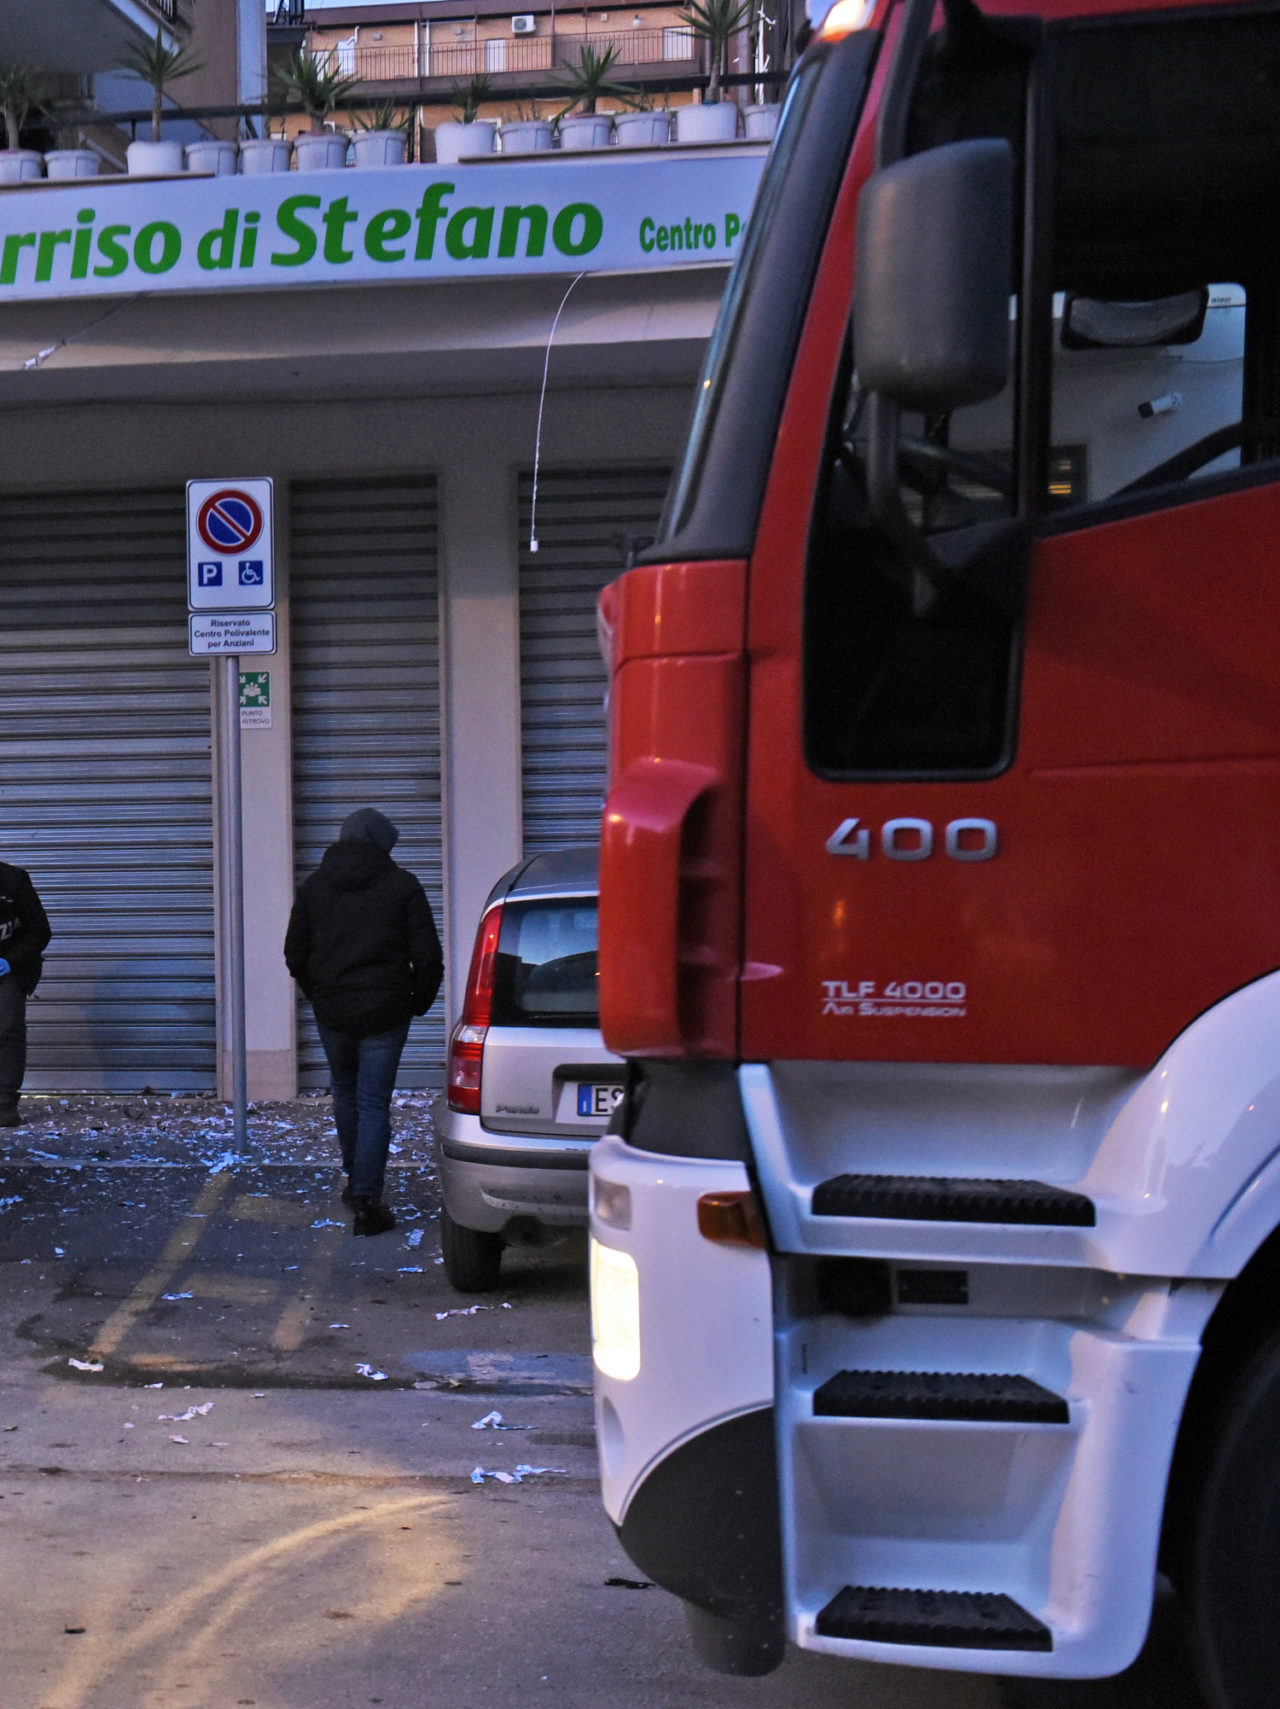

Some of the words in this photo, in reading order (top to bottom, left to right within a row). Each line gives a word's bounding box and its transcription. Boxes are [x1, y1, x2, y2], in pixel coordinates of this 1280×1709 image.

[196, 208, 261, 271] di
[270, 181, 604, 267] Stefano
[640, 216, 717, 253] Centro
[202, 564, 218, 585] P
[194, 630, 222, 638] Centro
[224, 628, 270, 637] Polivalente
[210, 619, 251, 628] Riservato
[207, 641, 221, 650] per
[223, 639, 254, 647] Anziani
[825, 817, 997, 861] 400
[821, 980, 876, 998] TLF
[884, 981, 966, 999] 4000
